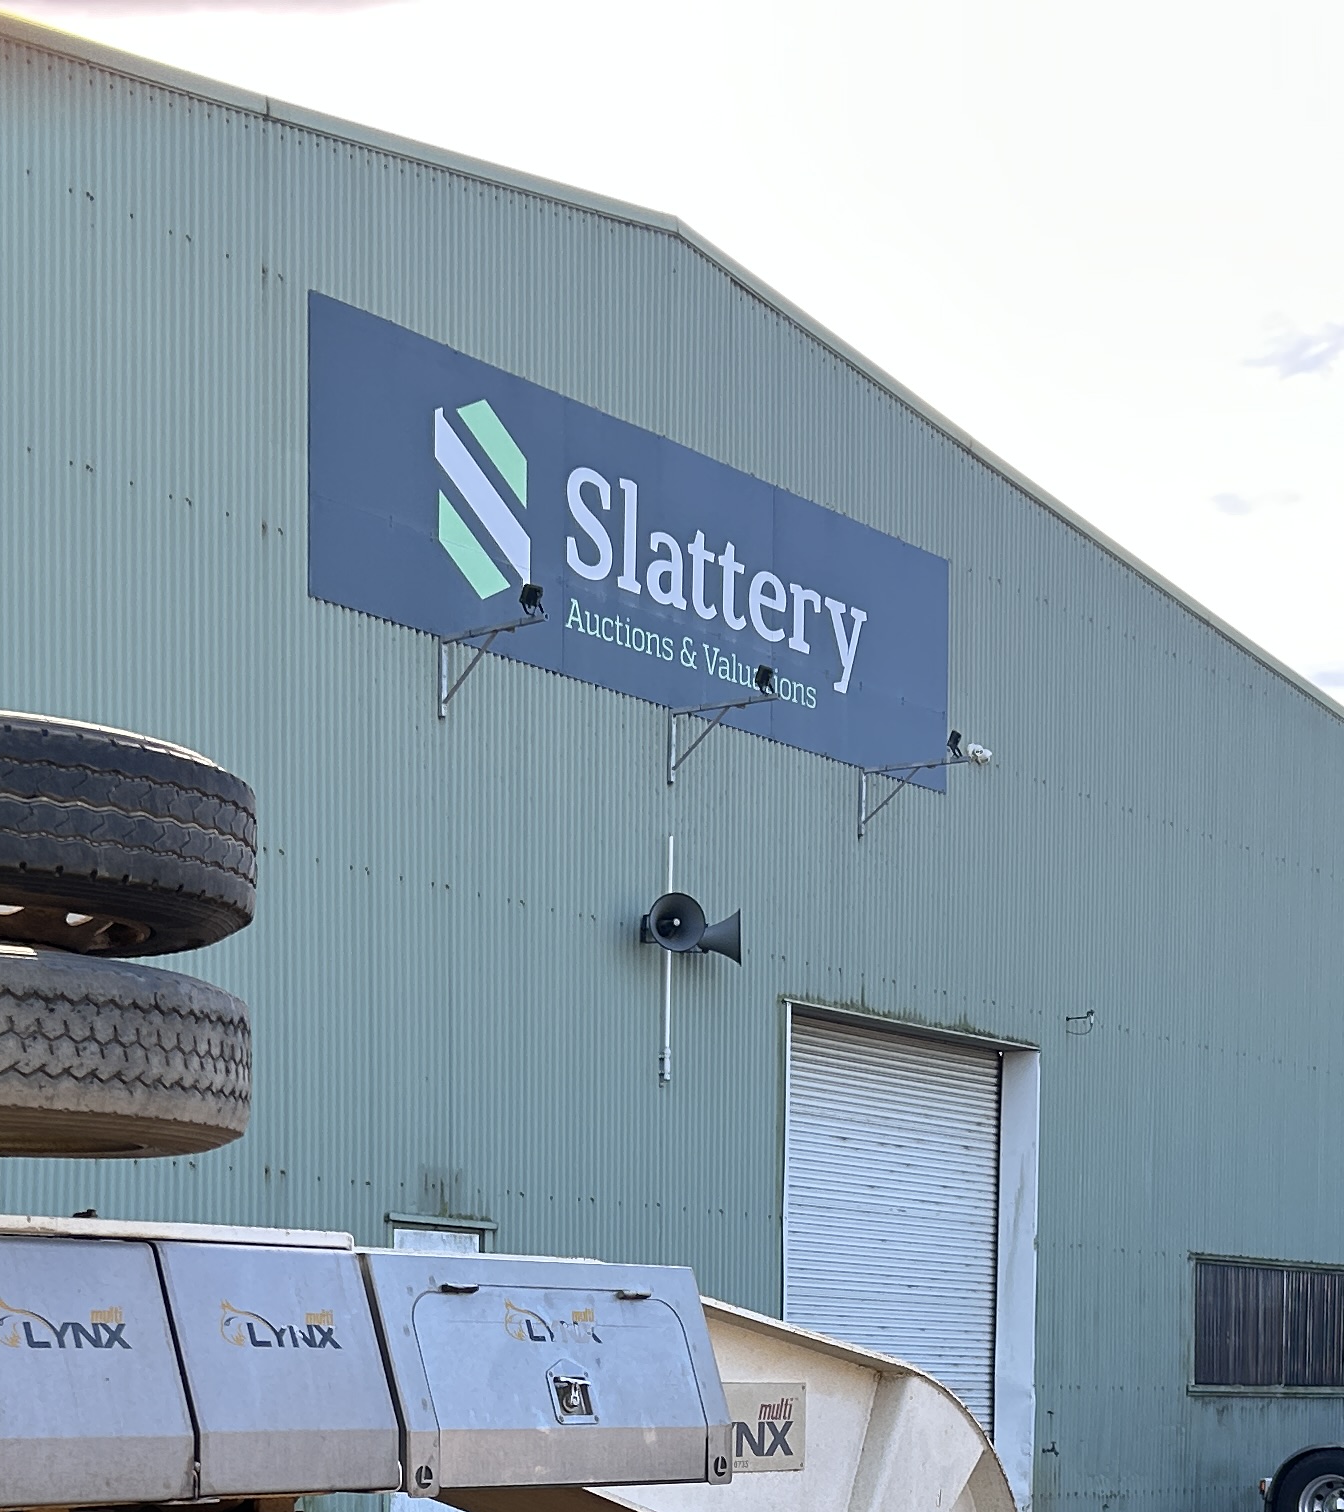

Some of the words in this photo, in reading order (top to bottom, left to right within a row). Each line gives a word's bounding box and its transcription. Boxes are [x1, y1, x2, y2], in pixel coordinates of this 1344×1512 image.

[566, 466, 867, 694] Slattery
[565, 598, 674, 662] Auctions
[680, 636, 698, 671] &
[702, 642, 817, 709] Valuions
[22, 1321, 133, 1350] LYNX
[246, 1322, 343, 1350] LYNX
[758, 1397, 794, 1421] multi
[732, 1421, 794, 1458] NX
